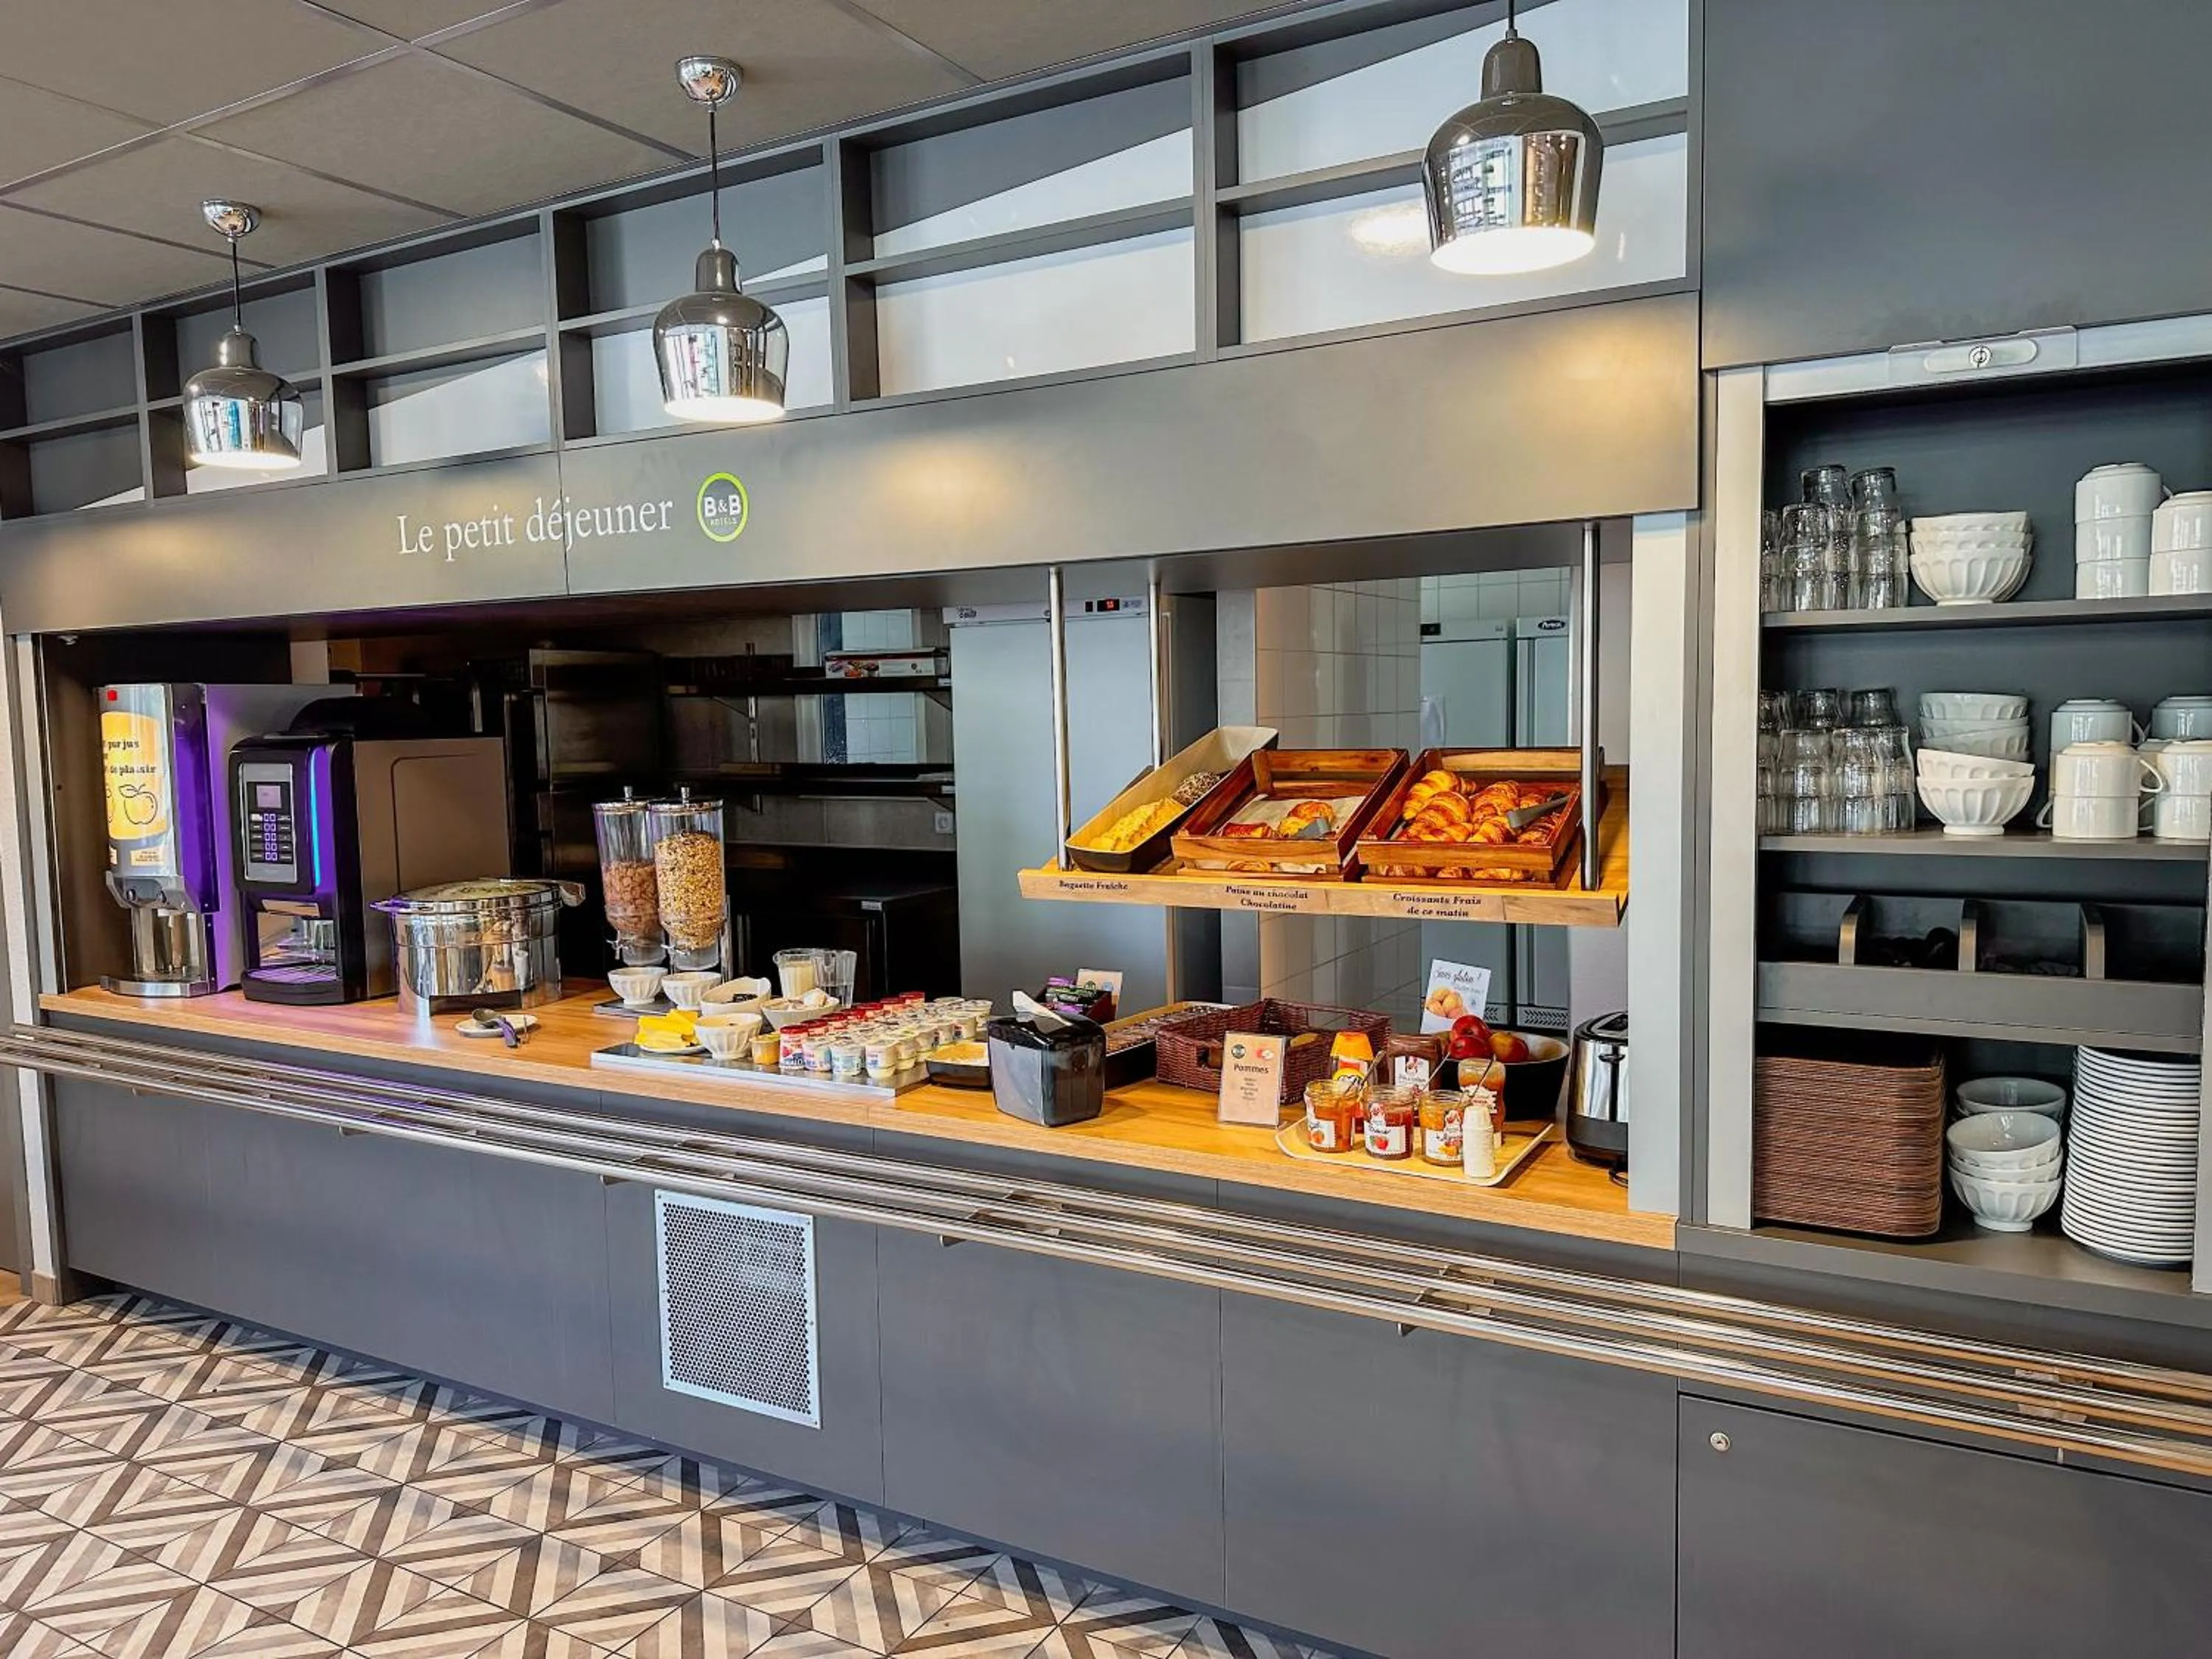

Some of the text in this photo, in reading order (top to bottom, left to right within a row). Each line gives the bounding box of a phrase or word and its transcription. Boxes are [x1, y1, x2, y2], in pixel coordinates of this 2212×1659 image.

[704, 494, 741, 518] B&B
[397, 495, 674, 563] Le petit déjeuner
[122, 739, 139, 750] jus
[1267, 889, 1308, 899] chocolat
[1393, 893, 1481, 905] Croissants Frais
[1240, 898, 1297, 910] Chocolatine
[1407, 906, 1419, 915] de
[1436, 908, 1469, 917] matin
[1234, 1064, 1270, 1074] Pommes
